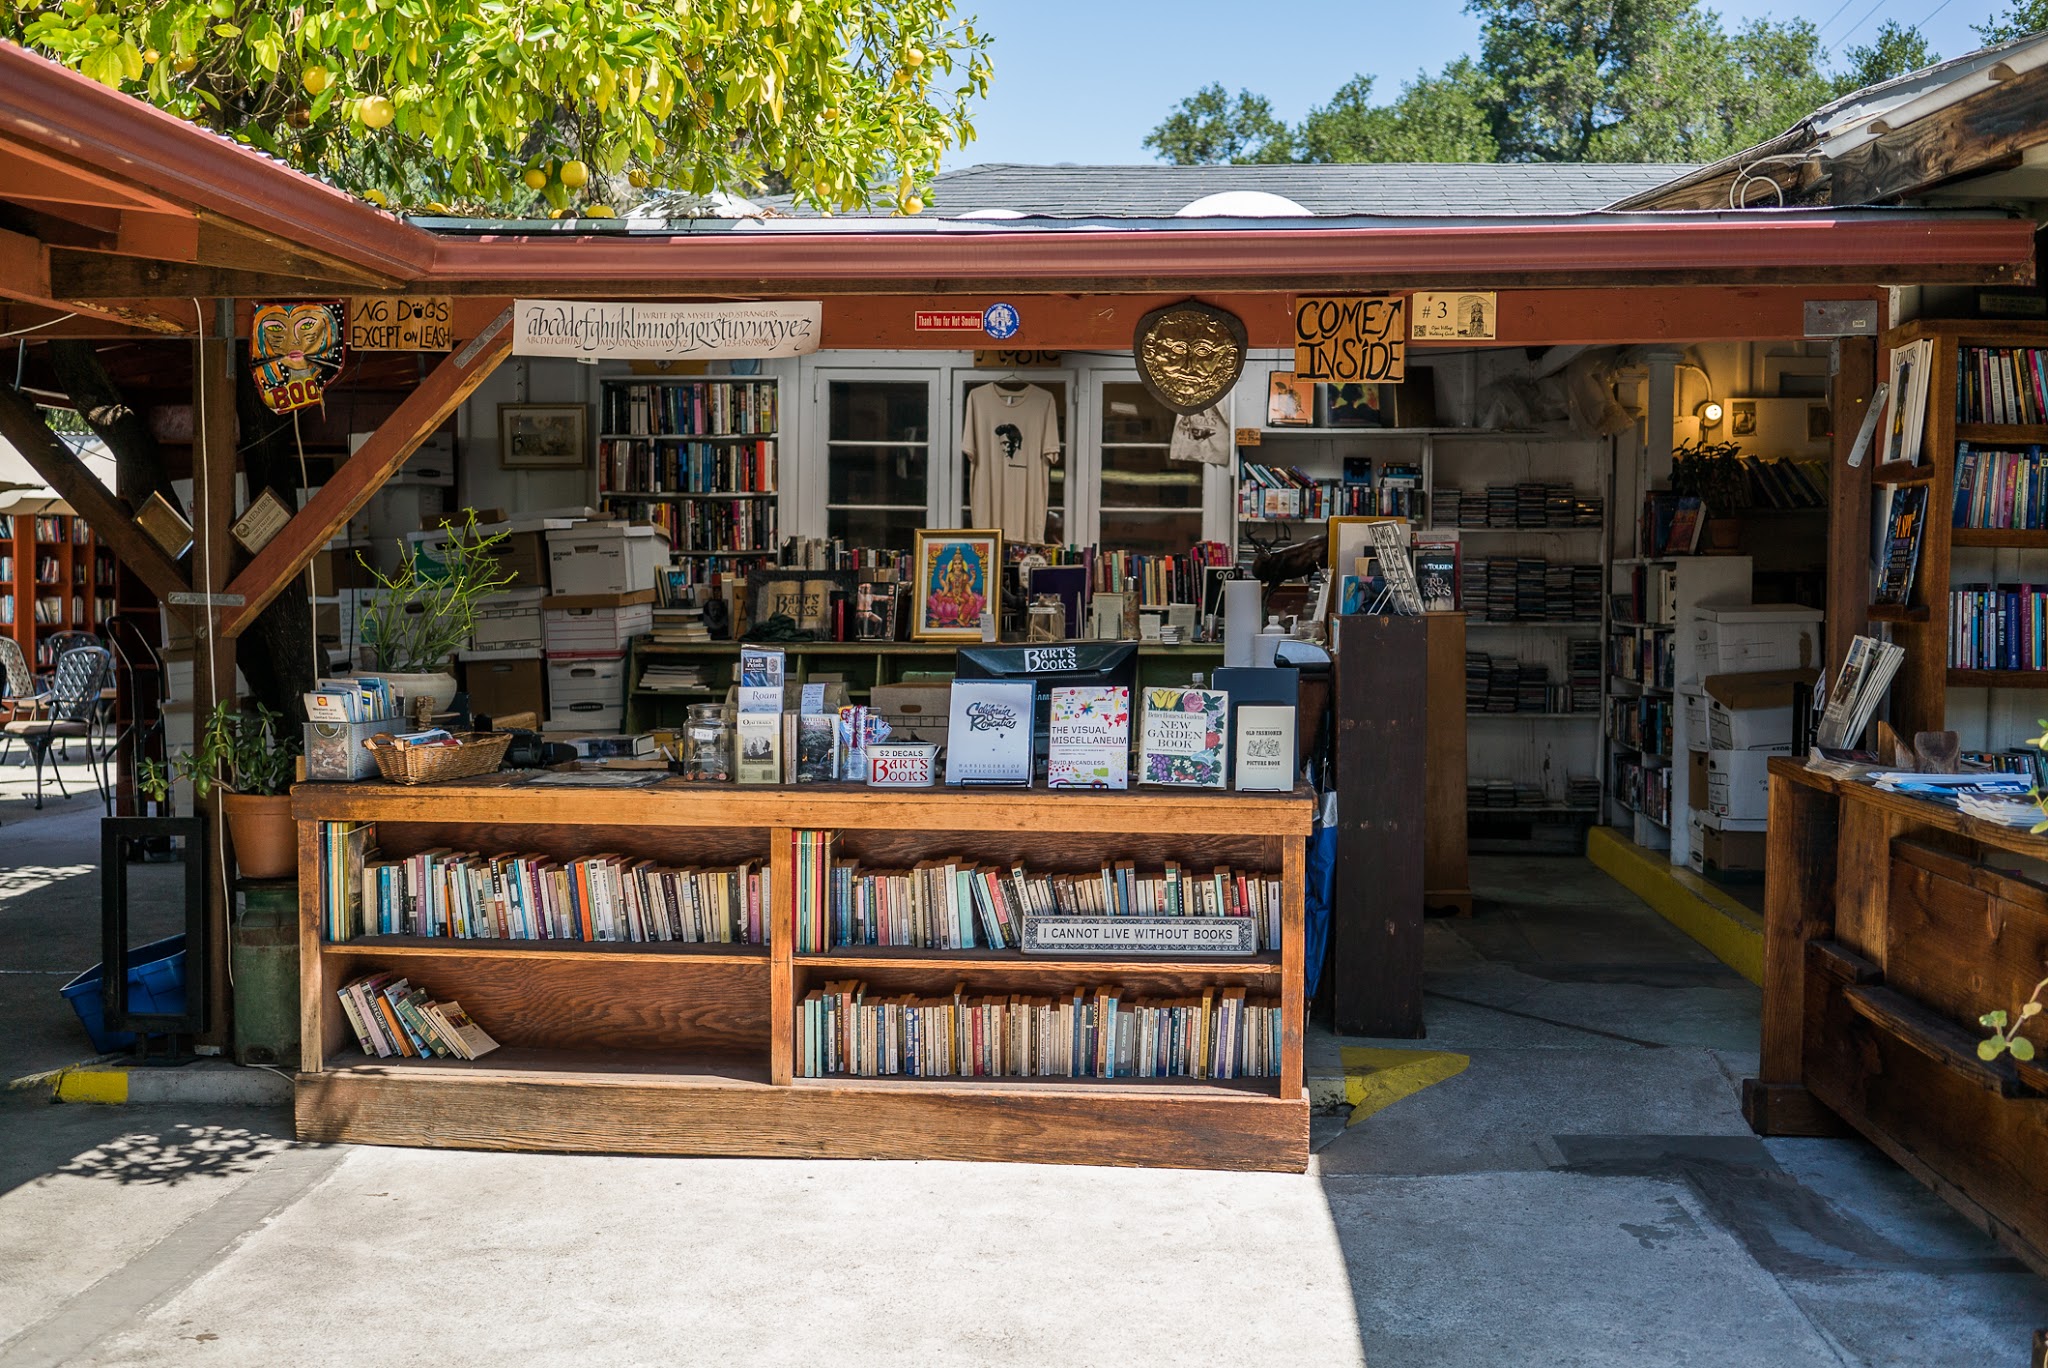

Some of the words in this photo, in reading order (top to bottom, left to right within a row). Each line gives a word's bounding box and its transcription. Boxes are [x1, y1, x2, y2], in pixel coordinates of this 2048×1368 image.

[352, 301, 388, 322] NO
[643, 312, 667, 320] WRITE
[670, 312, 685, 320] FOR
[687, 312, 714, 320] MYSELF
[717, 311, 735, 319] AND
[1436, 301, 1448, 319] 3
[918, 315, 932, 327] Thank
[933, 315, 942, 327] You
[942, 315, 950, 327] for
[951, 316, 960, 327] Not
[961, 316, 981, 329] Smoking
[1296, 299, 1384, 344] COME
[352, 325, 402, 348] EXCEPT
[419, 326, 451, 348] LEASH
[1297, 338, 1404, 380] INSIDE
[270, 379, 321, 409] BOO
[244, 494, 273, 526] MEMBER
[1427, 563, 1454, 571] TOLKIEN
[1024, 646, 1077, 663] BART'S
[752, 690, 778, 701] Roam
[966, 702, 1017, 720] California
[1052, 726, 1069, 734] THE
[1072, 726, 1107, 735] VISUAL
[1160, 720, 1191, 730] NEW
[1051, 736, 1127, 745] MISCELLANEUM
[1147, 729, 1203, 740] GARDEN
[1158, 739, 1192, 749] BOOK
[892, 749, 924, 757] DECALS
[873, 758, 929, 773] BART'S
[873, 770, 929, 783] BOOKS
[1043, 928, 1047, 939] I
[1051, 928, 1098, 940] CANNOT
[1103, 928, 1130, 940] LIVE
[1134, 928, 1189, 940] WITHOUT
[1193, 928, 1233, 940] BOOKS
